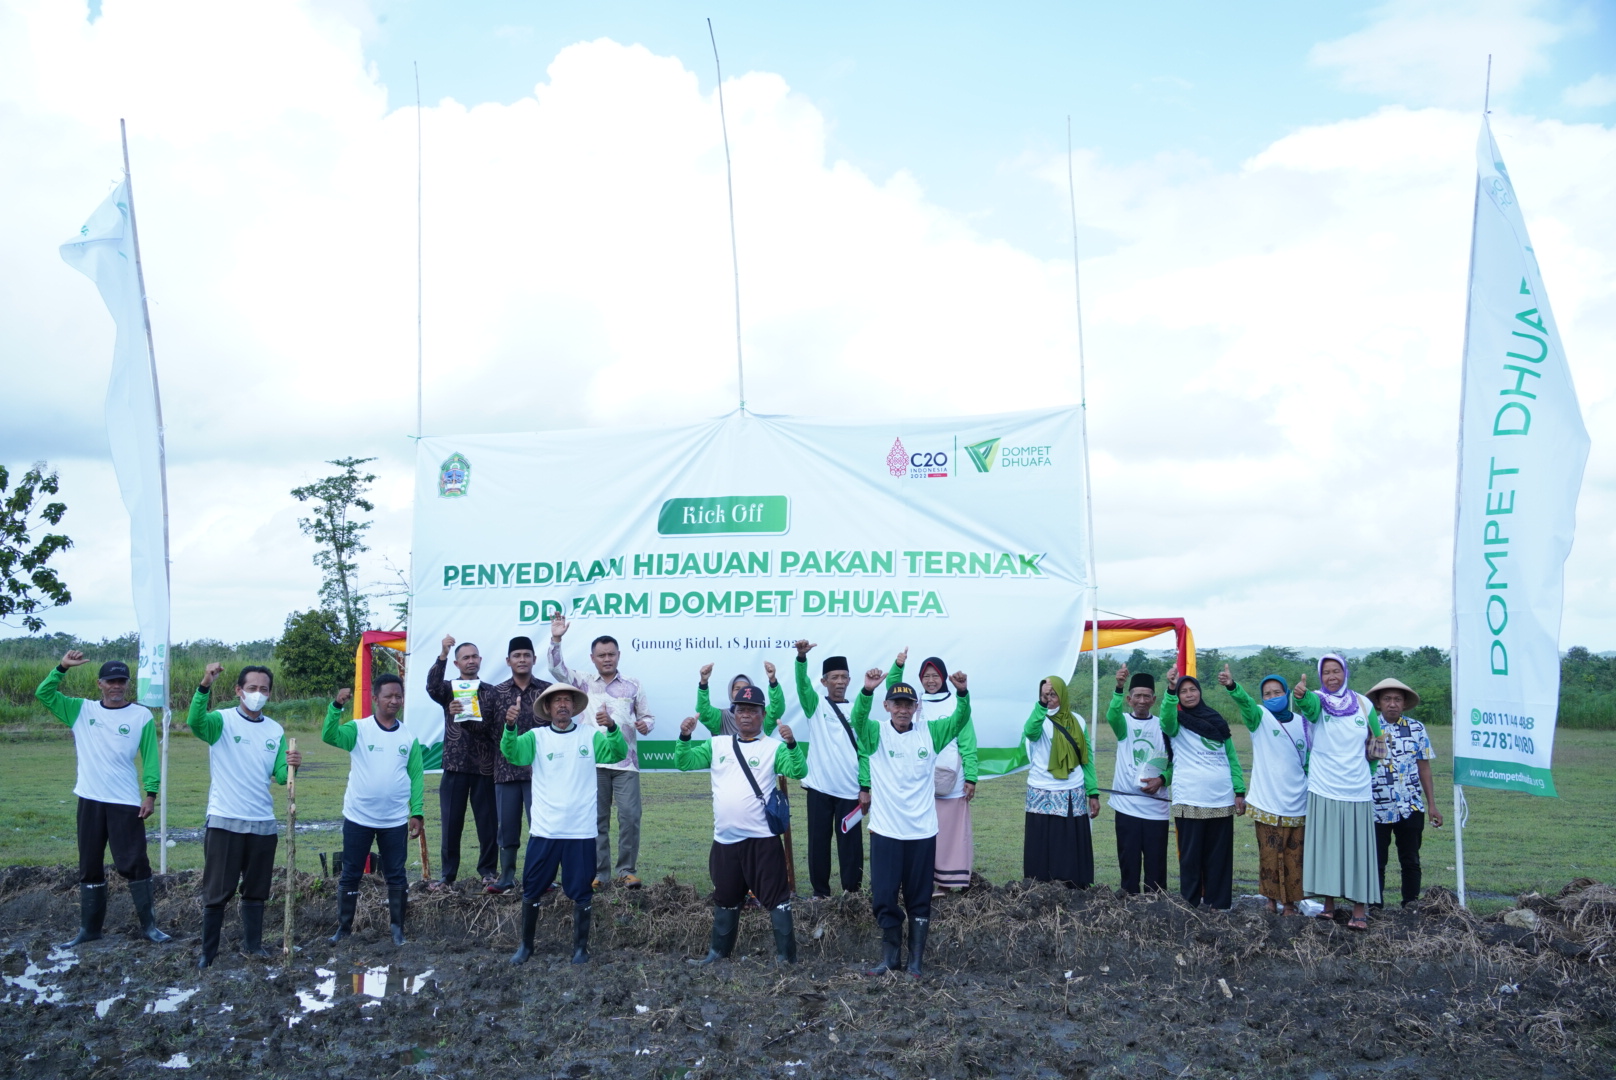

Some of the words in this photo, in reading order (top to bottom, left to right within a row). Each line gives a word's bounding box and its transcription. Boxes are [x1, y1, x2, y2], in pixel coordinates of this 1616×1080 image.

[1002, 446, 1052, 457] DOMPET
[910, 452, 948, 467] C20
[1002, 457, 1052, 467] DHUAFA
[682, 504, 726, 525] Kick
[731, 503, 764, 523] Off
[443, 555, 624, 587] PENYEDIAAN
[633, 551, 769, 576] HIJAUAN
[780, 550, 893, 574] PAKAN
[903, 551, 1043, 575] TERNAK
[1483, 456, 1520, 676] DOMPET
[519, 599, 563, 622] DD
[572, 592, 649, 616] FARM
[659, 590, 794, 615] DOMPET
[802, 590, 944, 614] DHUAFA
[631, 637, 682, 652] Gunung
[685, 637, 722, 650] Kidul,
[727, 637, 740, 649] 18
[743, 637, 771, 649] Juni
[775, 639, 798, 649] 202
[892, 686, 913, 695] ARMY
